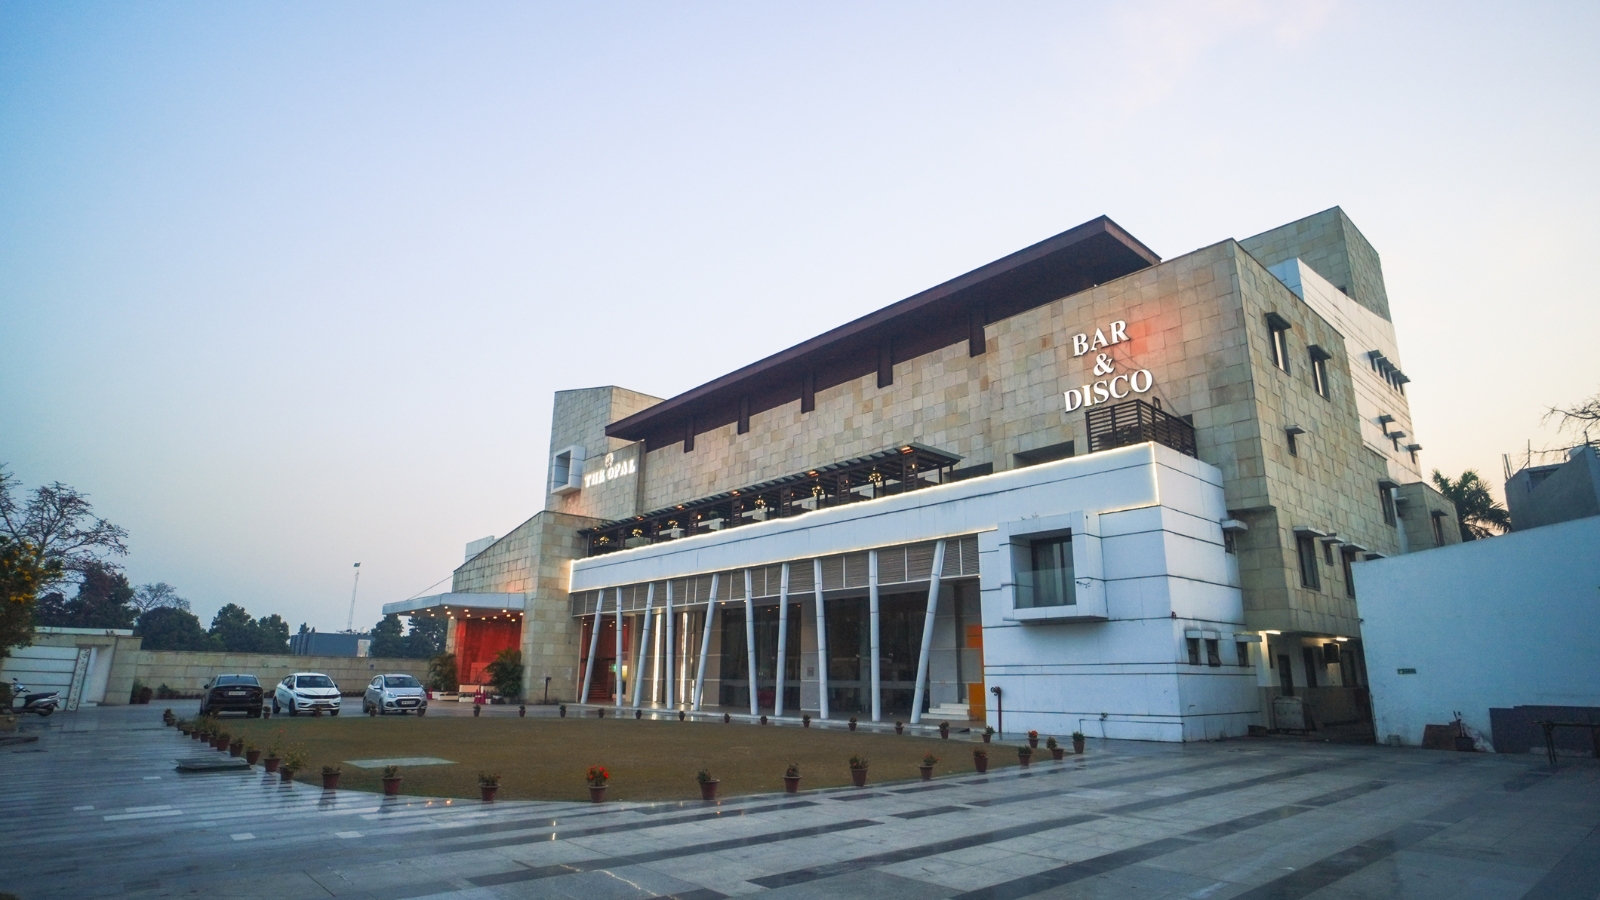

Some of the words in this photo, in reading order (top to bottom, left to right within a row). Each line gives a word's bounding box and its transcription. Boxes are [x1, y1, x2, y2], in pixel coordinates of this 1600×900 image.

[1071, 320, 1130, 357] BAR
[1093, 353, 1115, 376] &
[1063, 369, 1153, 412] DISCO
[584, 469, 605, 488] THE
[606, 459, 636, 480] OPAL
